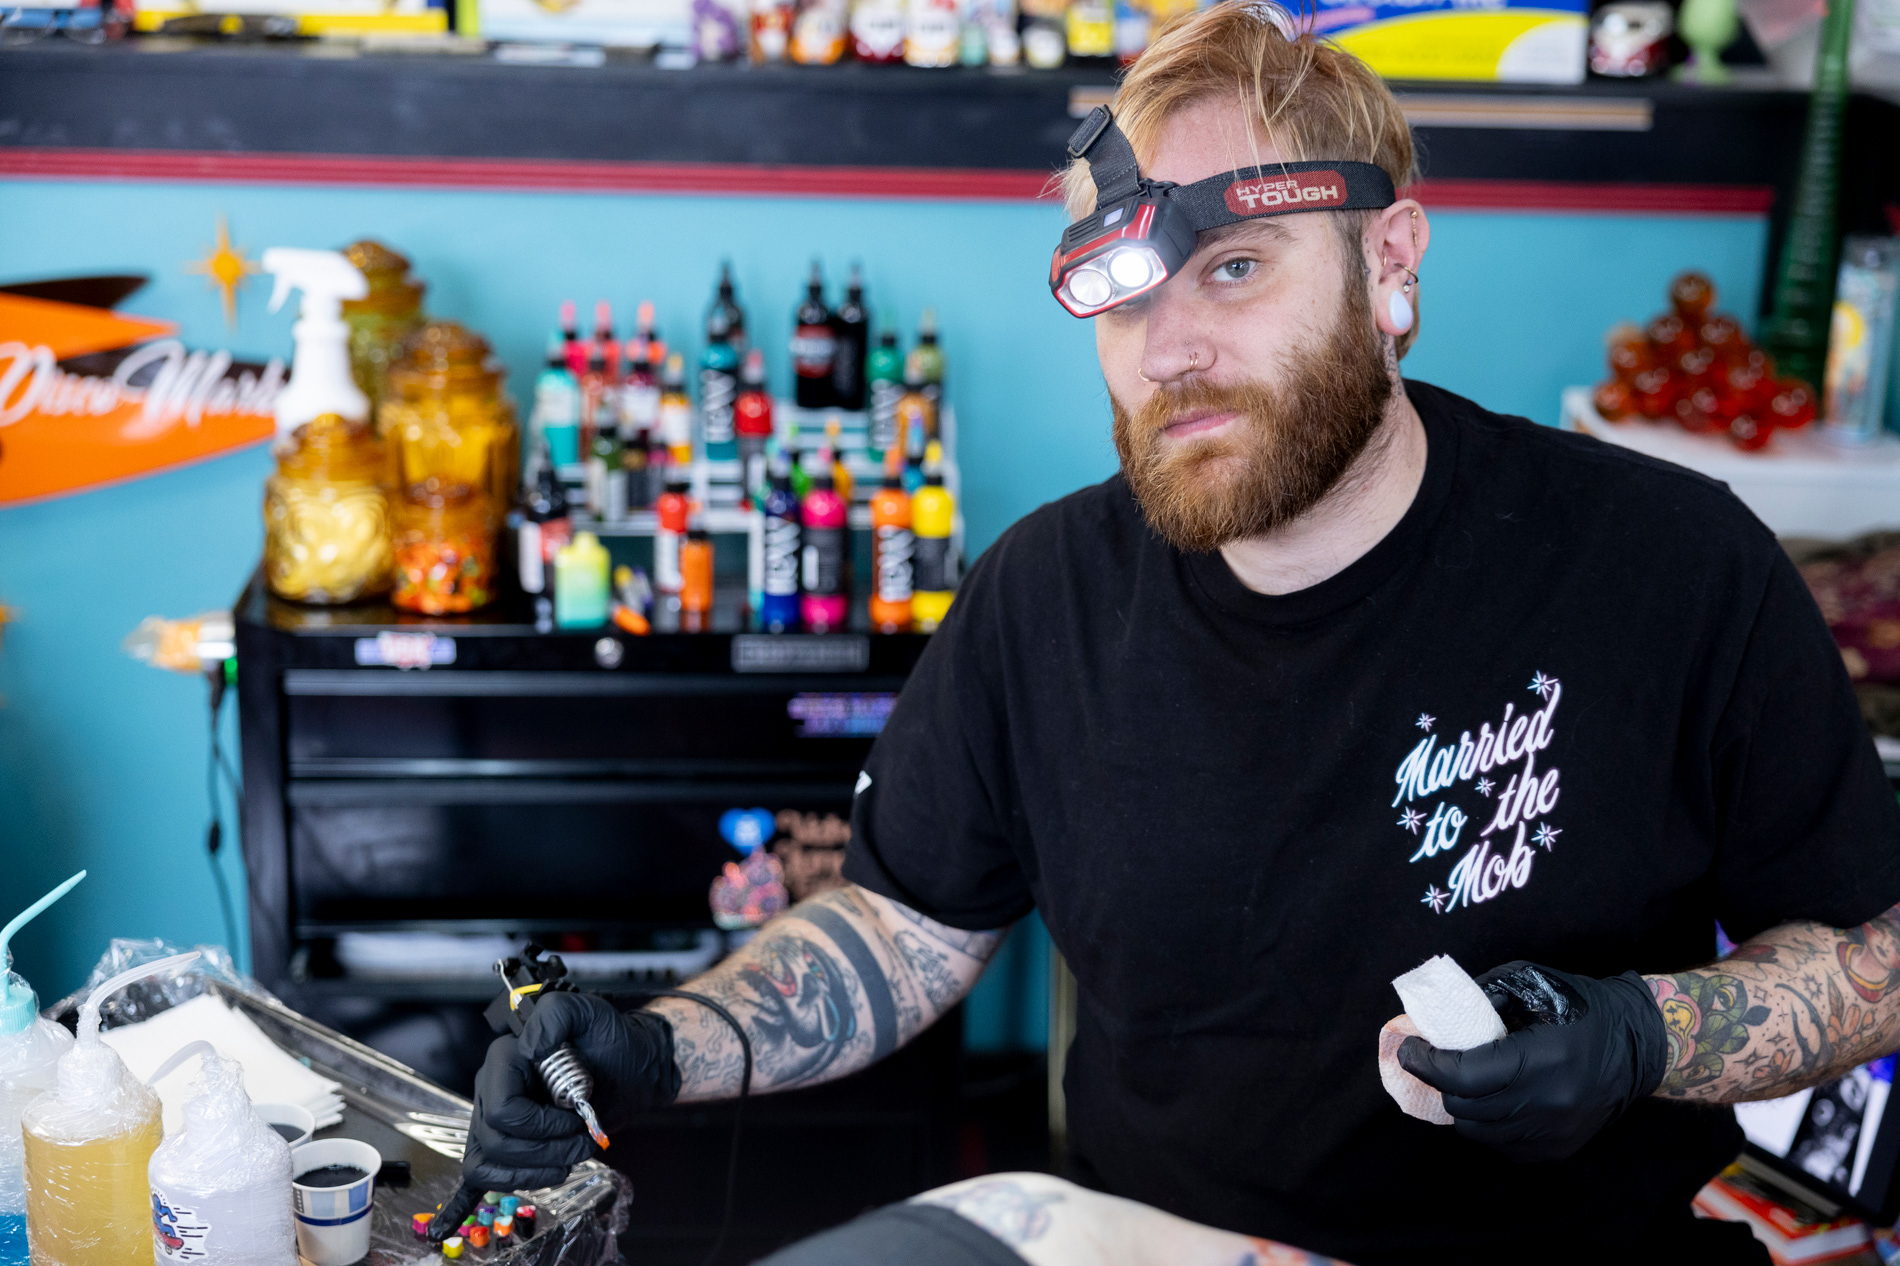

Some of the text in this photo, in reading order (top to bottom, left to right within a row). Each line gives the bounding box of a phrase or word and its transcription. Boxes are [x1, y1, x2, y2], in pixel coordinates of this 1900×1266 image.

[1236, 180, 1299, 196] HYPER
[1238, 185, 1339, 209] TOUGH
[1391, 682, 1562, 808] Married
[1409, 751, 1561, 864] to the
[1445, 820, 1537, 913] Mob
